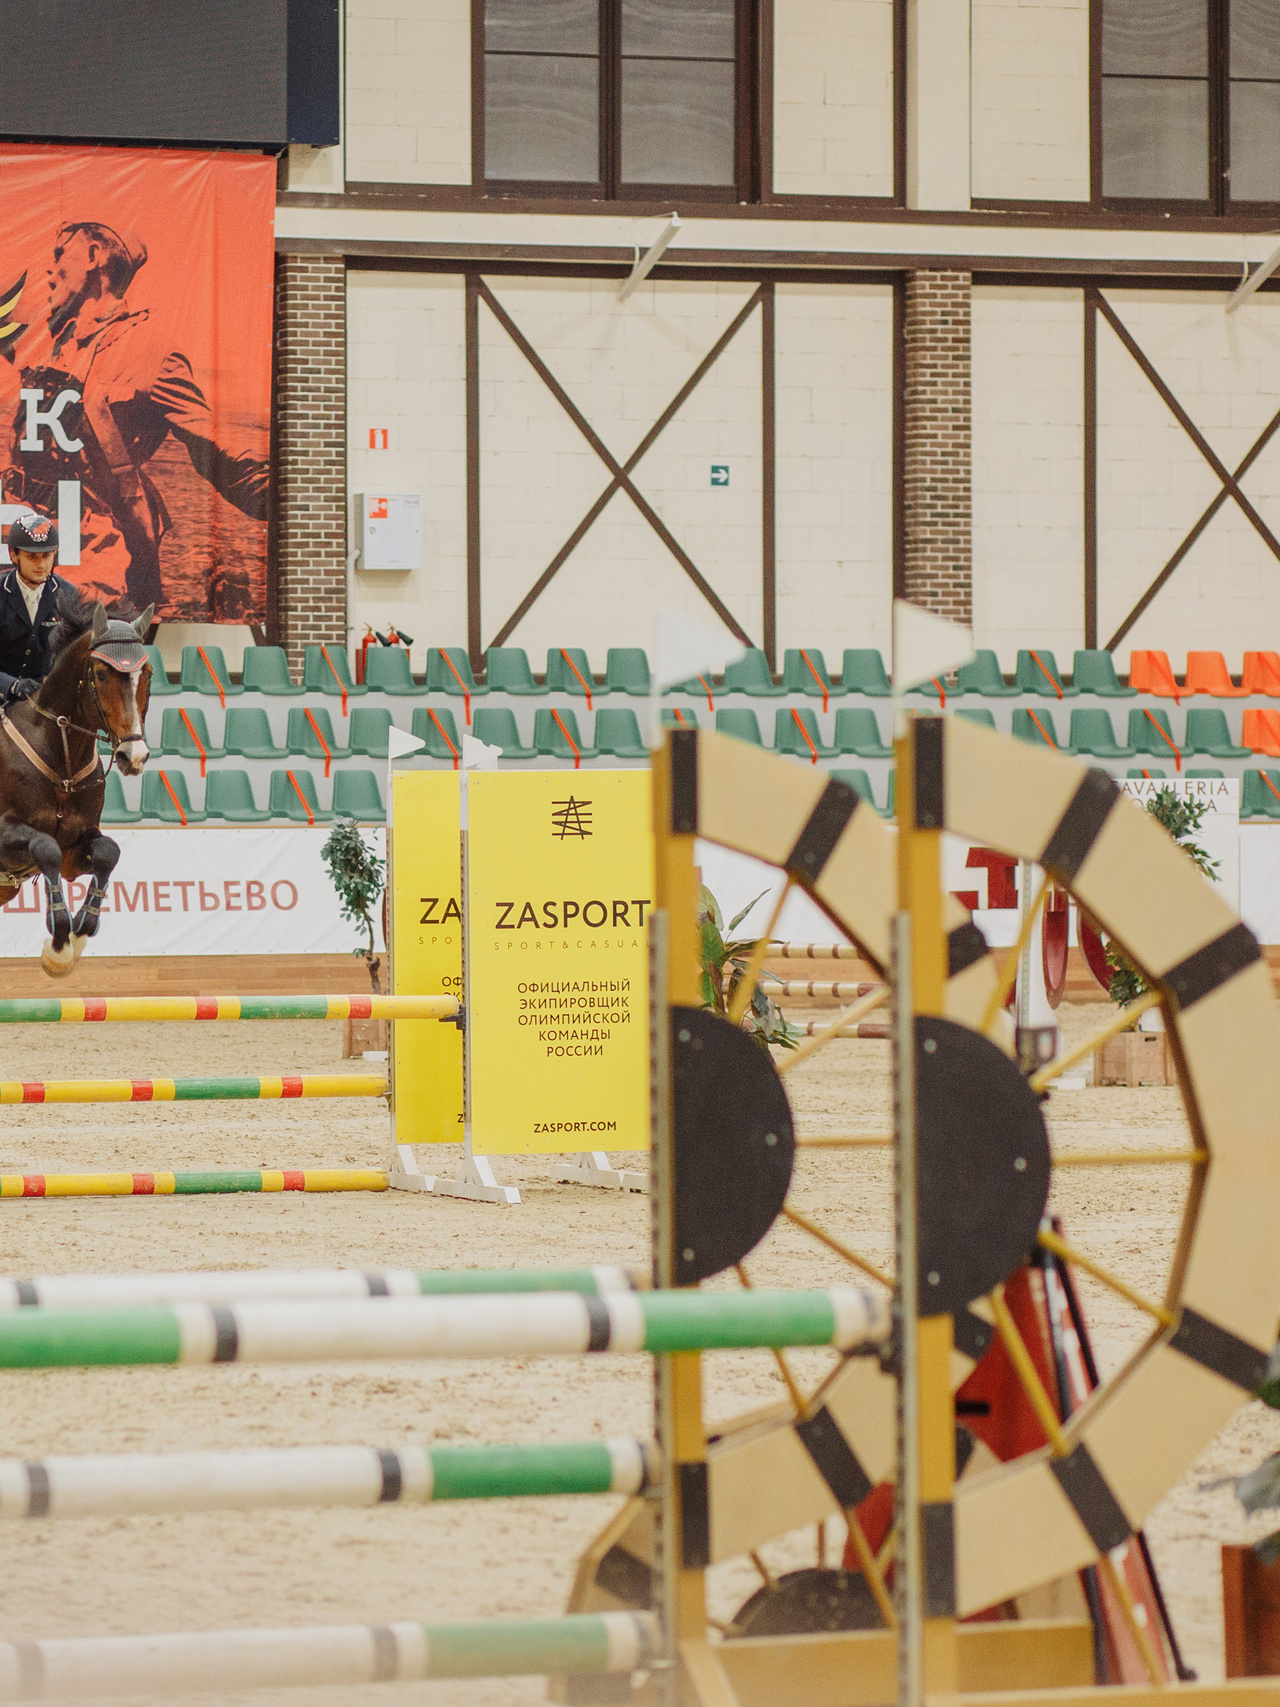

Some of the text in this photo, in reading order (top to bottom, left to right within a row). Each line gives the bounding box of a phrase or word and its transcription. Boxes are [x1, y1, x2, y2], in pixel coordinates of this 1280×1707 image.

[3, 879, 299, 914] ШРМЕТЬЕВО
[495, 900, 651, 929] ZASPORT
[517, 978, 631, 994] ОФИЦИАЛЬНЫЙ
[519, 997, 629, 1010] ЭКИПИРОВЩИК
[517, 1010, 631, 1026] ОЛИМПИЙСКОЙ
[539, 1029, 611, 1042] КОМАНДЫ
[547, 1045, 603, 1058] РОССИИ
[534, 1121, 617, 1133] ZASPORT.COM
